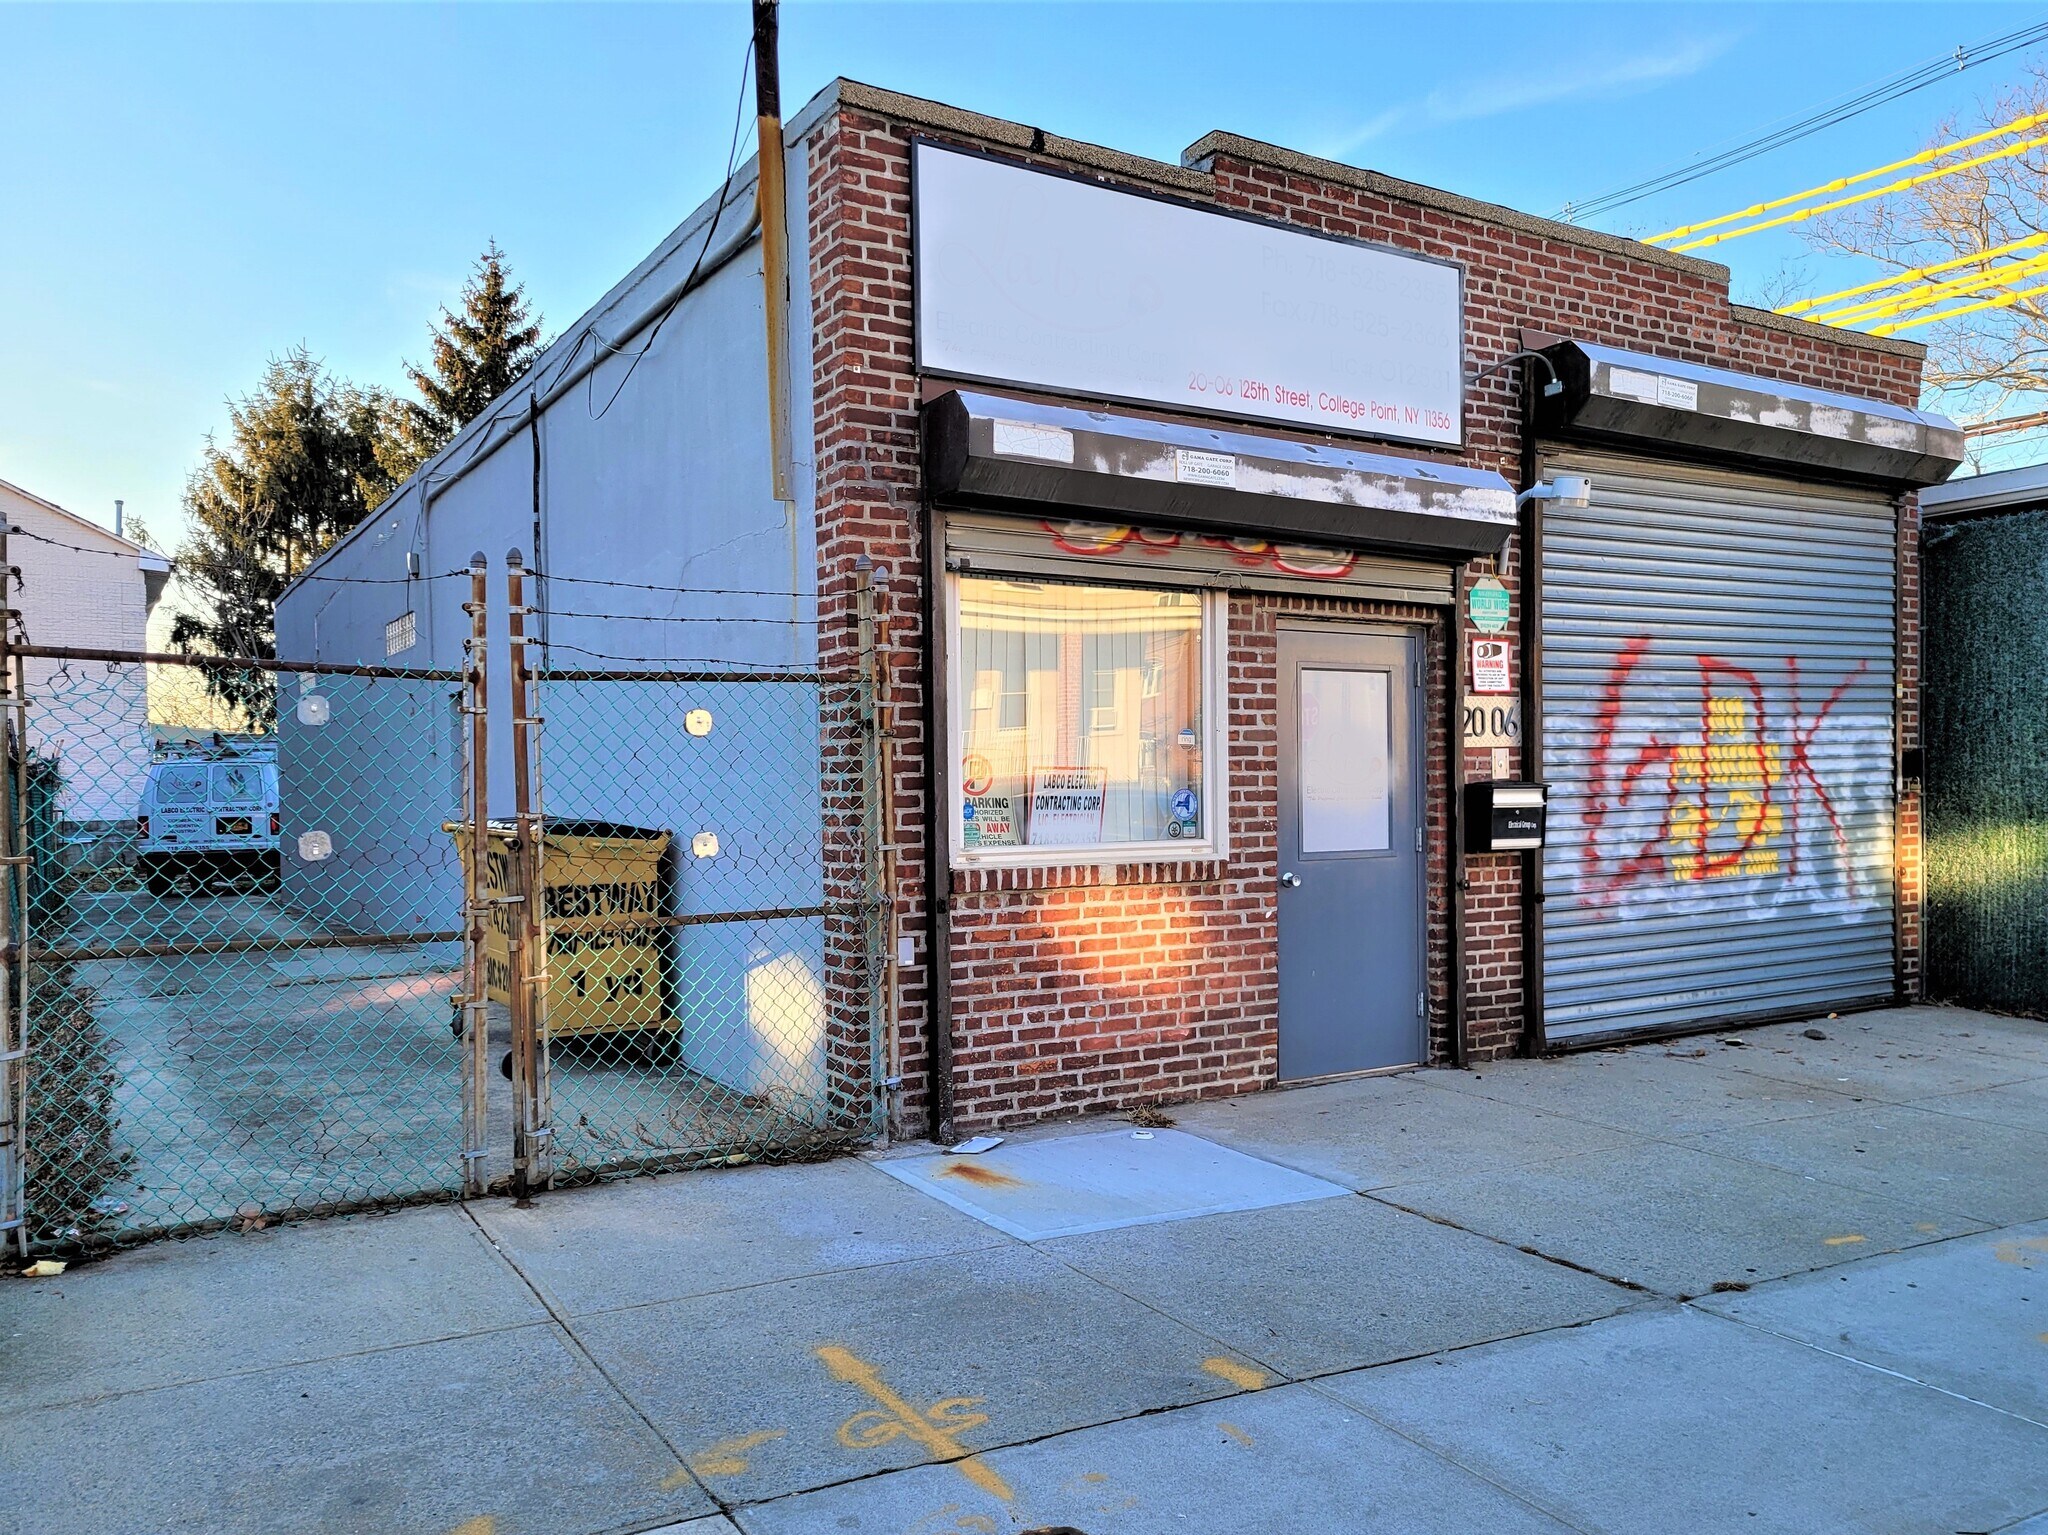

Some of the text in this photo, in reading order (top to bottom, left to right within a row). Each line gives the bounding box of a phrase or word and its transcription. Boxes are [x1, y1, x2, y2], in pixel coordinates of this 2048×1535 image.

[1188, 370, 1451, 430] 20-06 125th Street, College Point, NY 11356
[1661, 389, 1693, 401] 718-200-6060
[1182, 465, 1230, 477] 718-200-6060
[1472, 598, 1491, 610] WORLD
[1476, 660, 1504, 669] WARNING
[1491, 706, 1518, 738] 06
[1043, 774, 1098, 790] LABCO ELECTRIC
[1035, 795, 1100, 811] CONTRACTING CORP.
[986, 822, 1010, 833] AWAY
[545, 881, 657, 918] BESTWAY
[570, 970, 586, 997] 1
